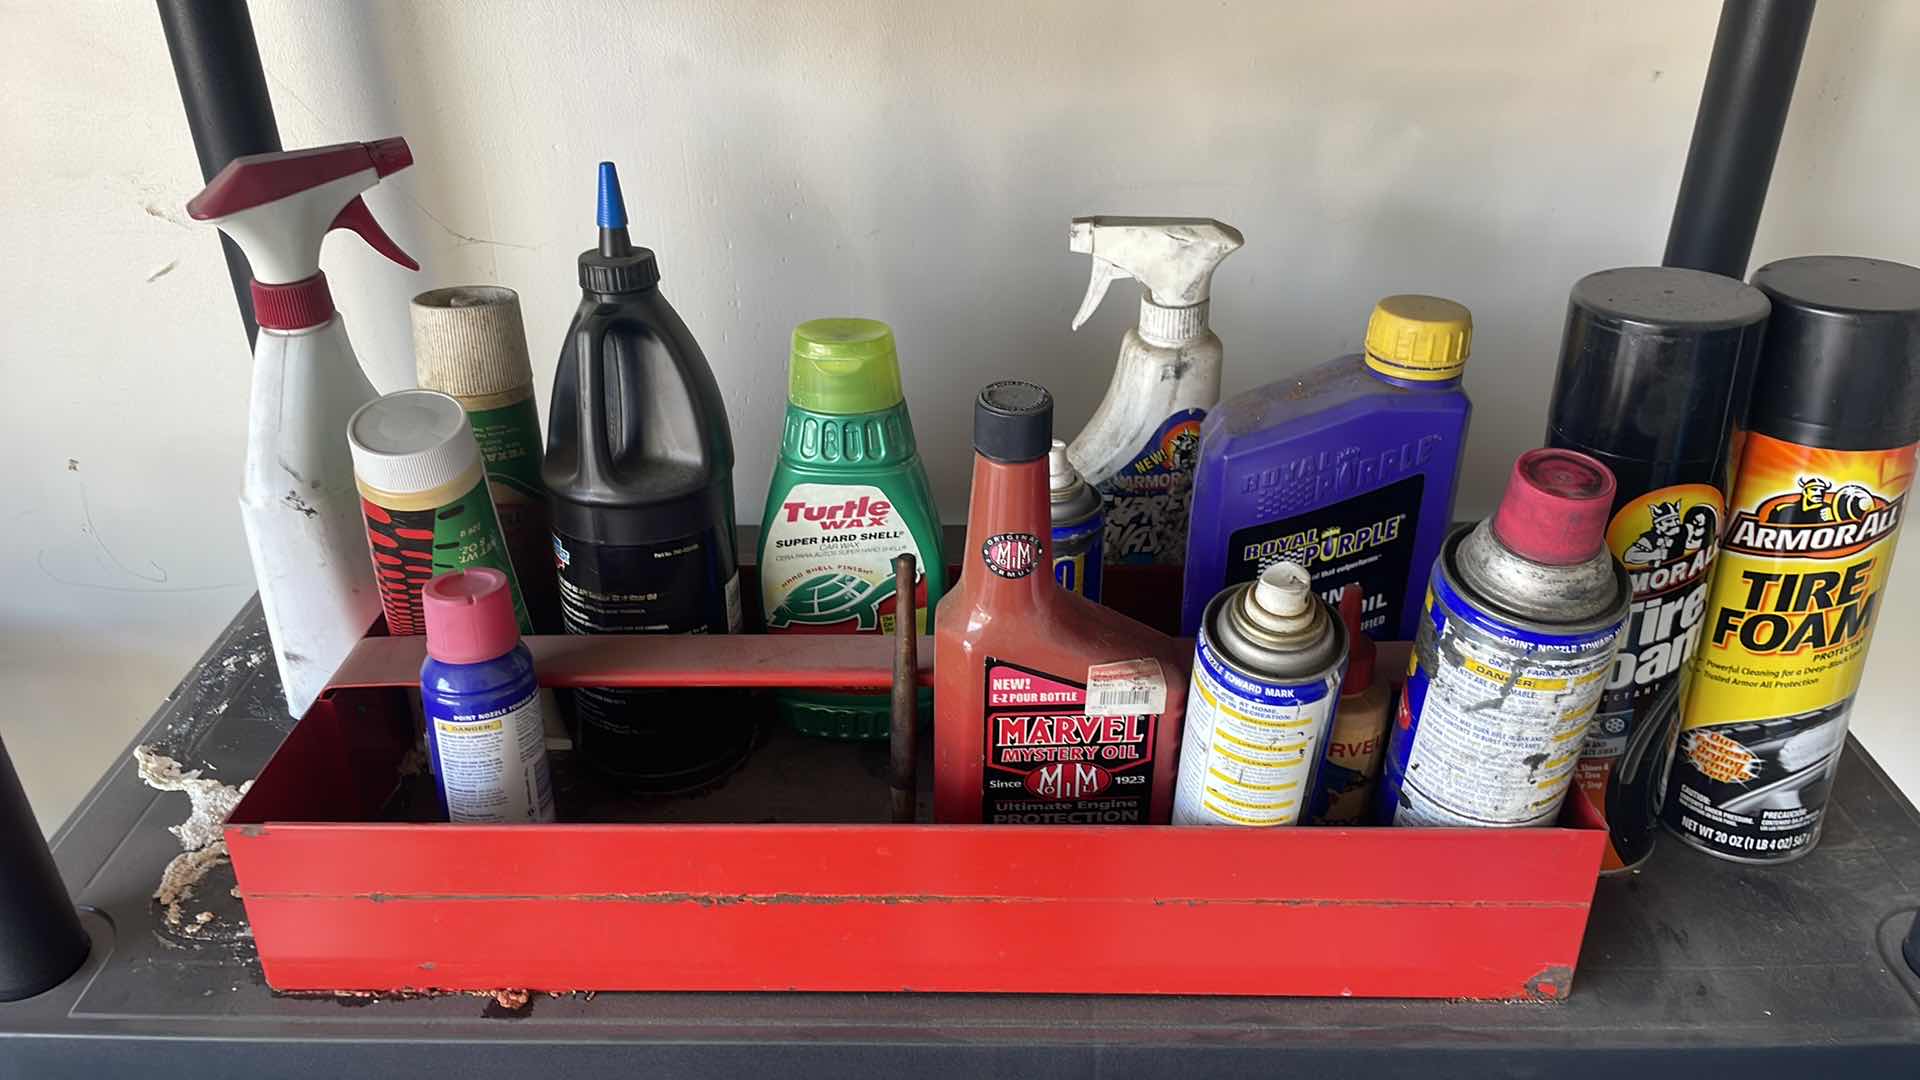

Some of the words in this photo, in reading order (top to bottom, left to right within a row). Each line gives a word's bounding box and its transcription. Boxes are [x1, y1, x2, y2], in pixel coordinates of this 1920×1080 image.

[1135, 448, 1168, 474] NEW!
[784, 496, 891, 523] Turtle
[820, 517, 888, 531] WAX
[775, 537, 818, 549] SUPER
[821, 534, 857, 544] HARD
[819, 542, 839, 551] CAR
[840, 541, 860, 549] WAX
[986, 534, 1039, 546] ORIGINAL
[1244, 528, 1319, 561] ROYAL
[1303, 516, 1401, 567] PURPLE
[805, 564, 834, 575] SHELL
[1742, 558, 1873, 612] TIRE
[1713, 592, 1876, 652] FOAM
[1502, 636, 1534, 650] POINT
[1537, 644, 1577, 654] NOZZLE
[1706, 658, 1739, 674] Powerful
[1741, 667, 1780, 679] Cleaning
[1782, 667, 1794, 678] for
[992, 678, 1031, 691] NEW!
[1225, 670, 1262, 694] TOWARD
[1265, 687, 1295, 698] MARK
[1703, 671, 1731, 684] Trusted
[1731, 678, 1758, 688] Armor
[1760, 680, 1773, 689] All
[1774, 677, 1819, 689] Protection
[992, 693, 1009, 704] E-Z
[1010, 692, 1037, 703] POUR
[1039, 691, 1078, 702] BOTTLE
[478, 708, 507, 720] NOZZLE
[996, 714, 1144, 746] MARVEL
[1001, 746, 1100, 763] MYSTERY
[1102, 745, 1139, 759] OIL
[989, 779, 1022, 789] Since
[1115, 775, 1146, 784] 1923
[996, 800, 1073, 811] Ultimate
[1077, 799, 1137, 811] Engine
[993, 810, 1139, 824] PROTECTION
[1681, 815, 1699, 833] NET
[1699, 822, 1715, 840] WT
[1714, 831, 1728, 844] 20
[1728, 834, 1745, 848] OZ
[1744, 836, 1754, 850] (1
[1756, 838, 1769, 850] LB
[1769, 839, 1777, 850] 4
[1777, 836, 1793, 850] OZ)
